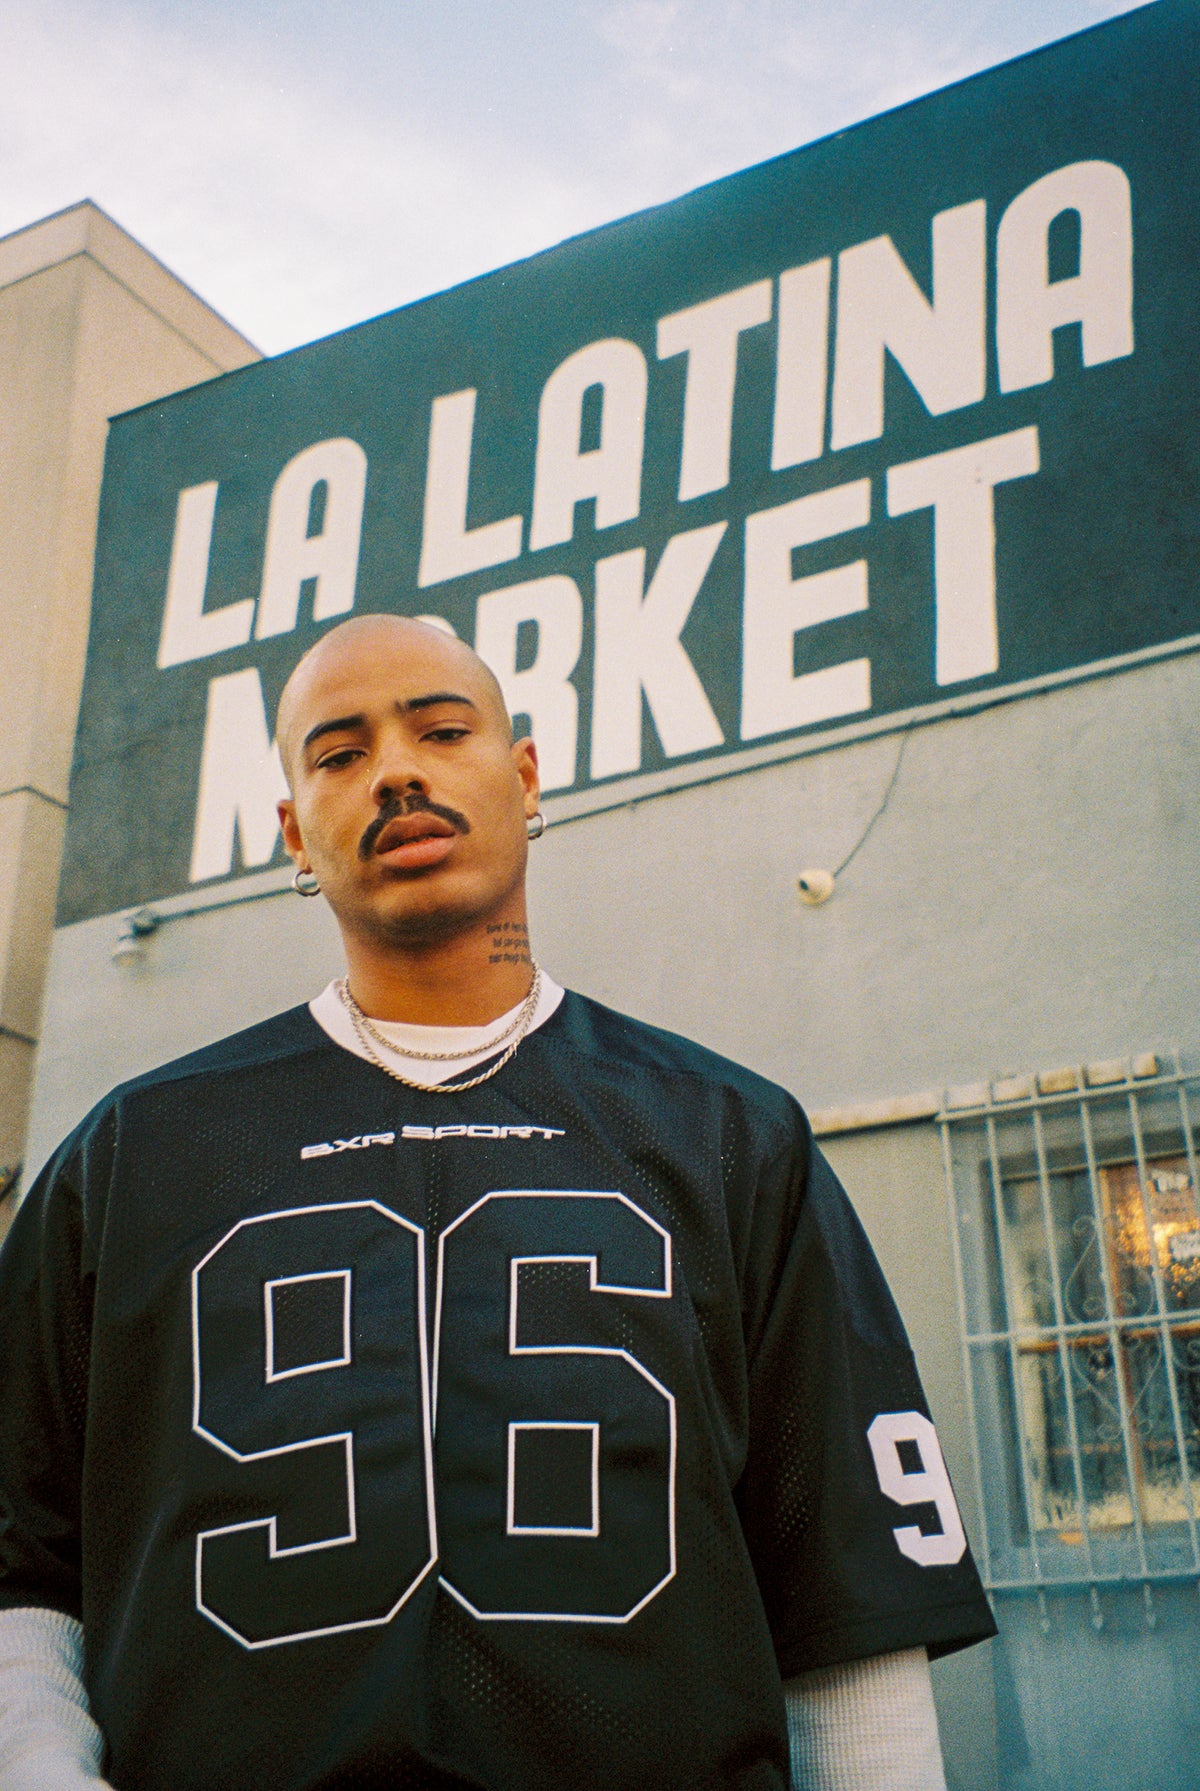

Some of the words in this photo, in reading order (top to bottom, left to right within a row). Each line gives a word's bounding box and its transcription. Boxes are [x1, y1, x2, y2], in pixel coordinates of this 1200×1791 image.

[156, 436, 368, 669] LA
[417, 159, 1135, 588] LATINA
[188, 425, 1040, 883] MRKET
[401, 1125, 566, 1140] SPORT
[191, 1189, 678, 1651] 96
[866, 1410, 967, 1567] 9
